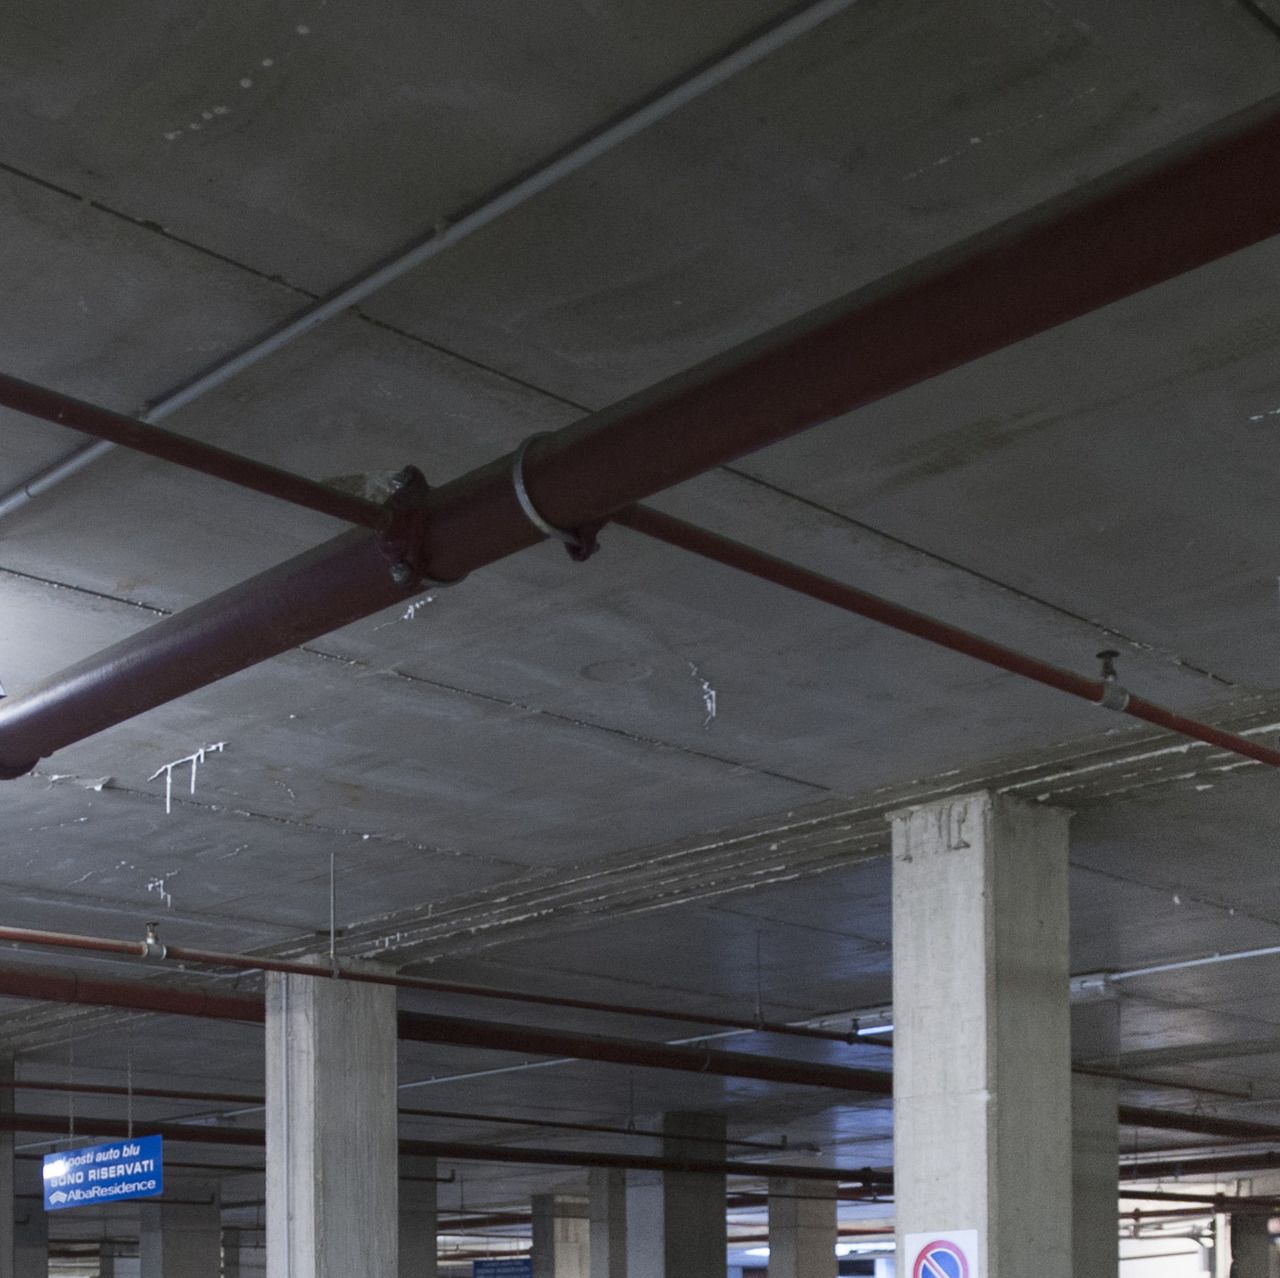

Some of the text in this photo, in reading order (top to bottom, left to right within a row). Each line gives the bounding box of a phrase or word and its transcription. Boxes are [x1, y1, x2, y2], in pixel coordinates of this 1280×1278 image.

[96, 1147, 120, 1161] auto
[122, 1143, 140, 1158] blu
[88, 1159, 154, 1182] RISERVATI
[67, 1179, 156, 1202] AlbaResidence
